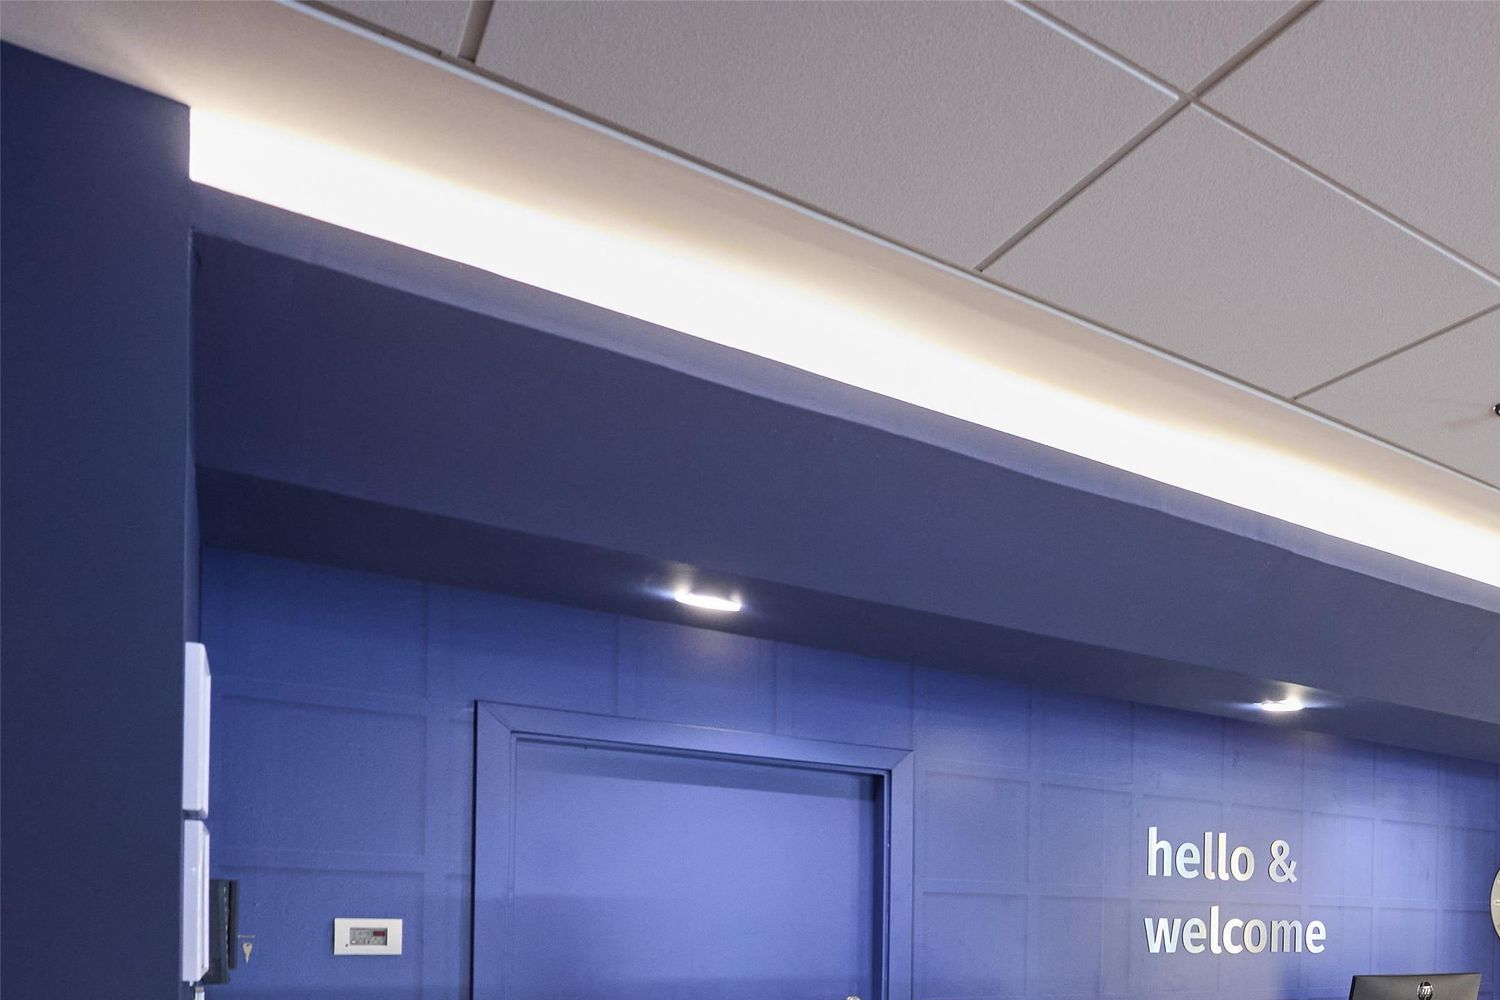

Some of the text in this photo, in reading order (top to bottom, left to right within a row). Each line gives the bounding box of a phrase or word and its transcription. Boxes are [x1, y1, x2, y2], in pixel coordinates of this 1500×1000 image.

[1147, 826, 1298, 884] hello &
[1144, 905, 1327, 955] welcome
